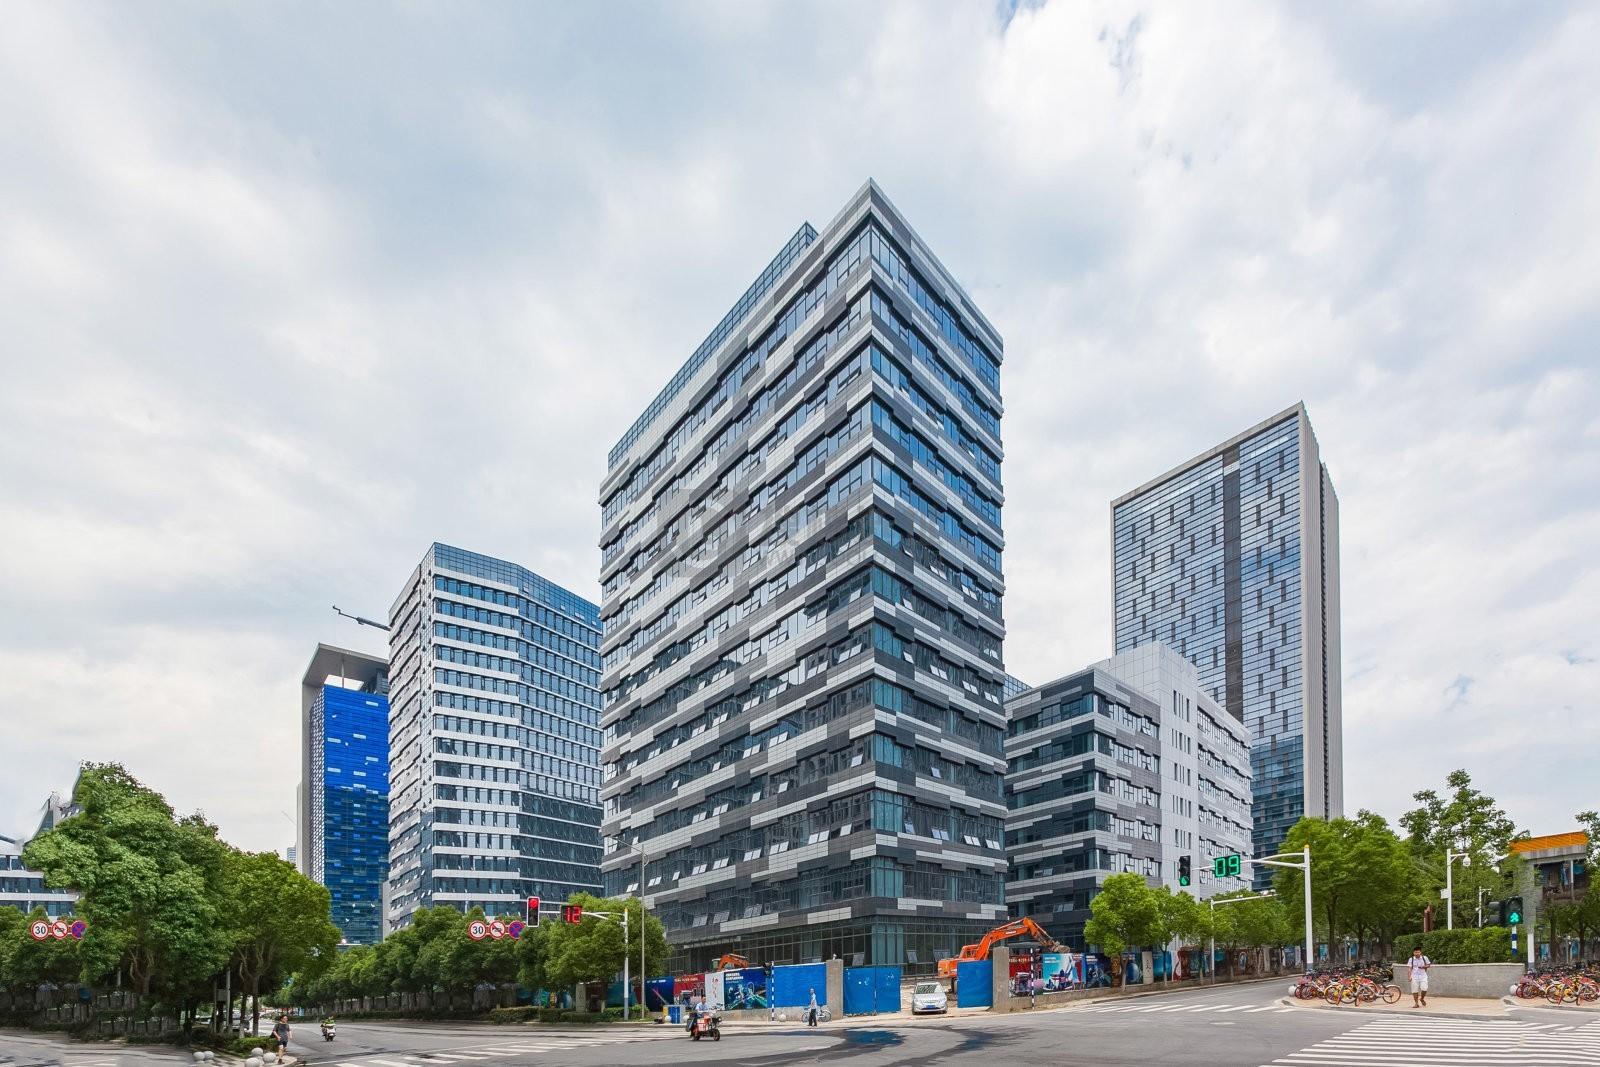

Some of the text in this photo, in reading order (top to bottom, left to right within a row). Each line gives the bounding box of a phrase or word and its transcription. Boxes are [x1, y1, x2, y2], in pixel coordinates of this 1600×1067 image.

[1215, 855, 1239, 877] 09
[567, 906, 581, 923] 12
[35, 925, 46, 935] 30
[472, 925, 484, 935] 30
